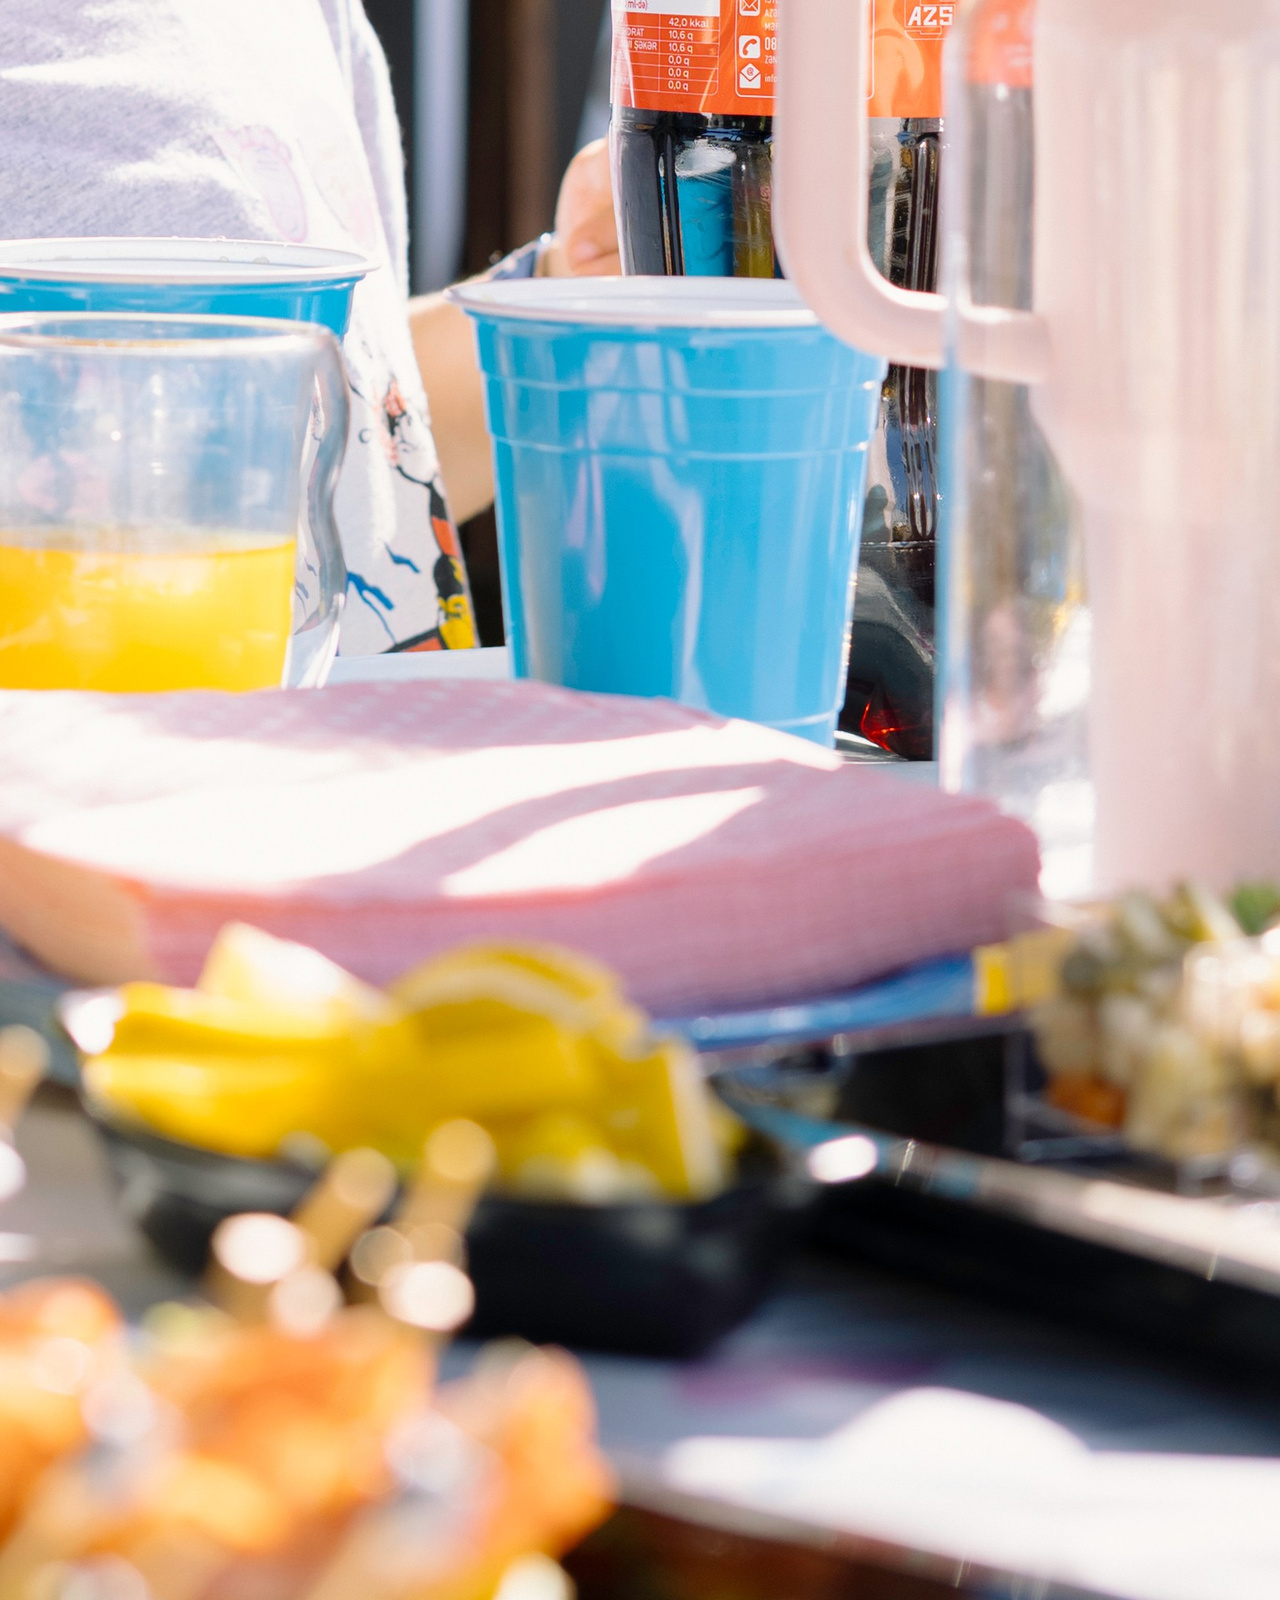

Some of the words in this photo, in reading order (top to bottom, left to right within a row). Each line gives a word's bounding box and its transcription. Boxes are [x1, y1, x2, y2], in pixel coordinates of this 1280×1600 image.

[668, 17, 688, 28] 42,0
[689, 18, 710, 29] kkal
[668, 30, 686, 40] 10,6
[686, 33, 694, 42] q
[634, 40, 658, 51] ŞƏKƏR
[668, 43, 686, 53] 10,6
[686, 46, 693, 54] q
[668, 55, 682, 66] 0,0
[683, 58, 690, 67] q
[668, 68, 682, 78] 0,0
[683, 70, 689, 79] q
[668, 80, 681, 91] 0,0
[682, 83, 689, 92] q
